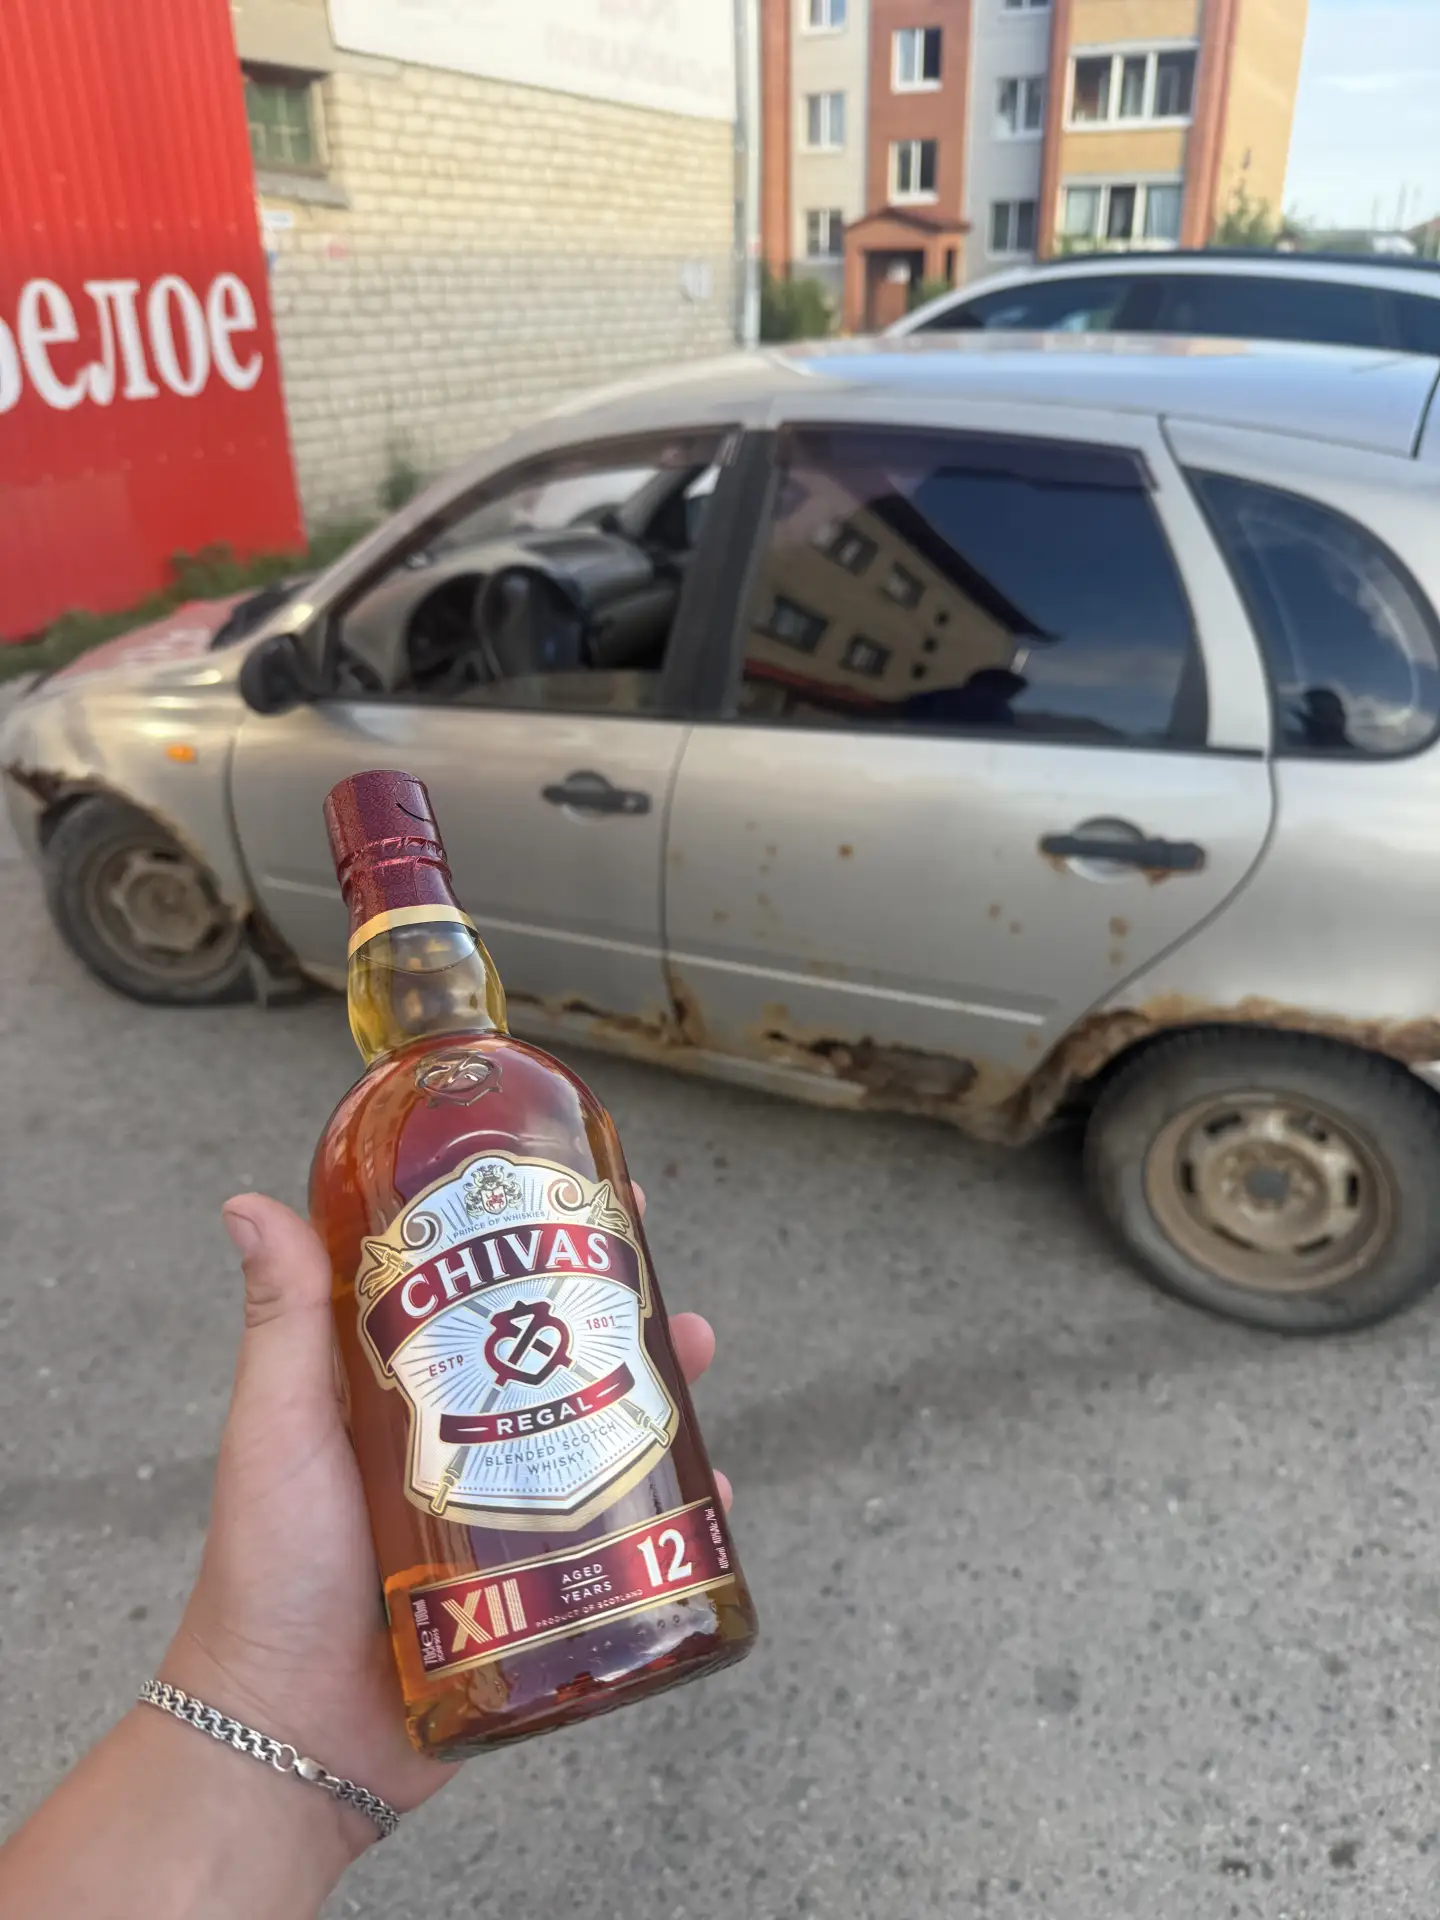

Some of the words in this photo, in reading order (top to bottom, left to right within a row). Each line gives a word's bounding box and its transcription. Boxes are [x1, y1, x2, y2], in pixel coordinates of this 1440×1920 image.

[453, 1222, 486, 1239] PRINCE
[488, 1218, 501, 1227] OF
[503, 1210, 546, 1223] WHISKIES
[400, 1227, 611, 1319] CHIVAS
[586, 1315, 616, 1331] 1801
[495, 1396, 593, 1436] REGAL
[485, 1445, 556, 1467] BLENDED
[563, 1421, 617, 1451] SCOTCH
[527, 1450, 585, 1475] WHISKY
[561, 1563, 603, 1584] AGED
[636, 1528, 693, 1588] 12
[535, 1609, 580, 1628] PRODUCT
[582, 1604, 595, 1614] OF
[597, 1588, 644, 1609] SCOTLAND
[560, 1581, 613, 1605] YEARS
[440, 1578, 528, 1653] XII
